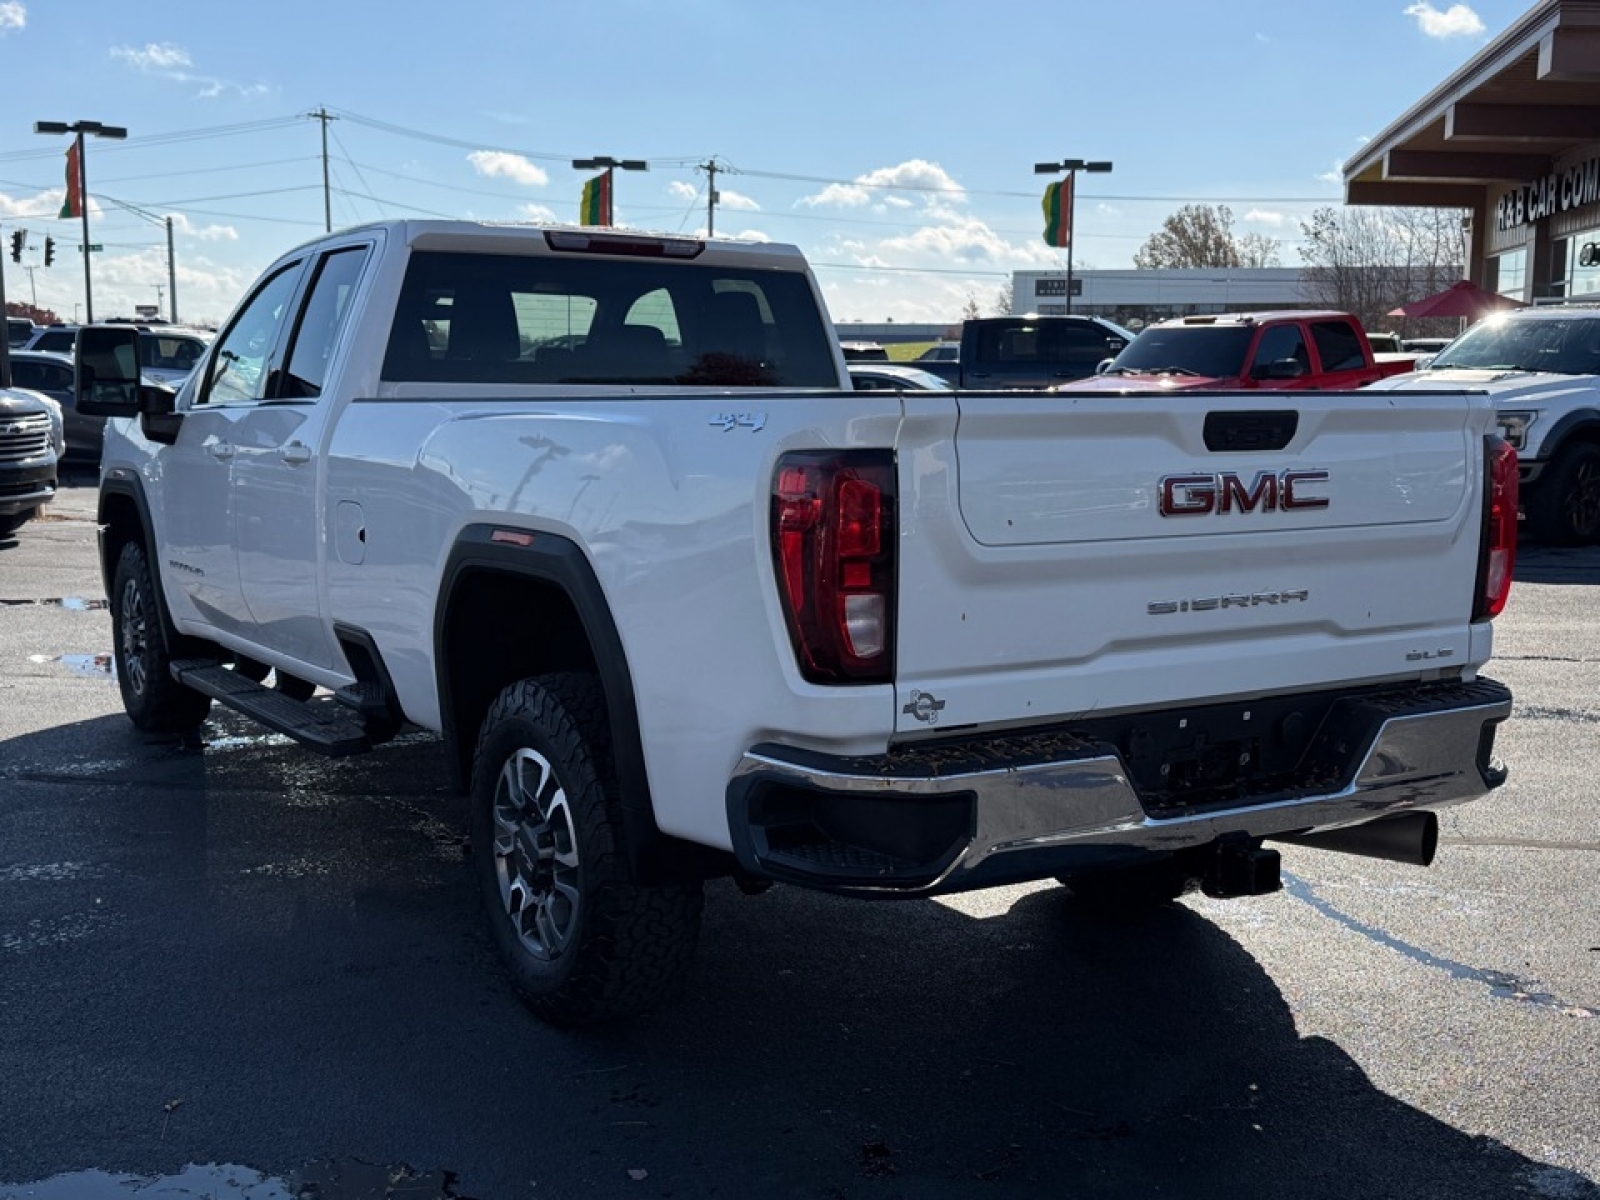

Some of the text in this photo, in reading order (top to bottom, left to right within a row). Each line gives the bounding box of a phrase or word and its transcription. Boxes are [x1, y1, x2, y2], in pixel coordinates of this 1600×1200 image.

[1498, 157, 1600, 230] R&B CAR COM
[1158, 468, 1330, 517] GMC
[1147, 589, 1309, 615] SIERRA
